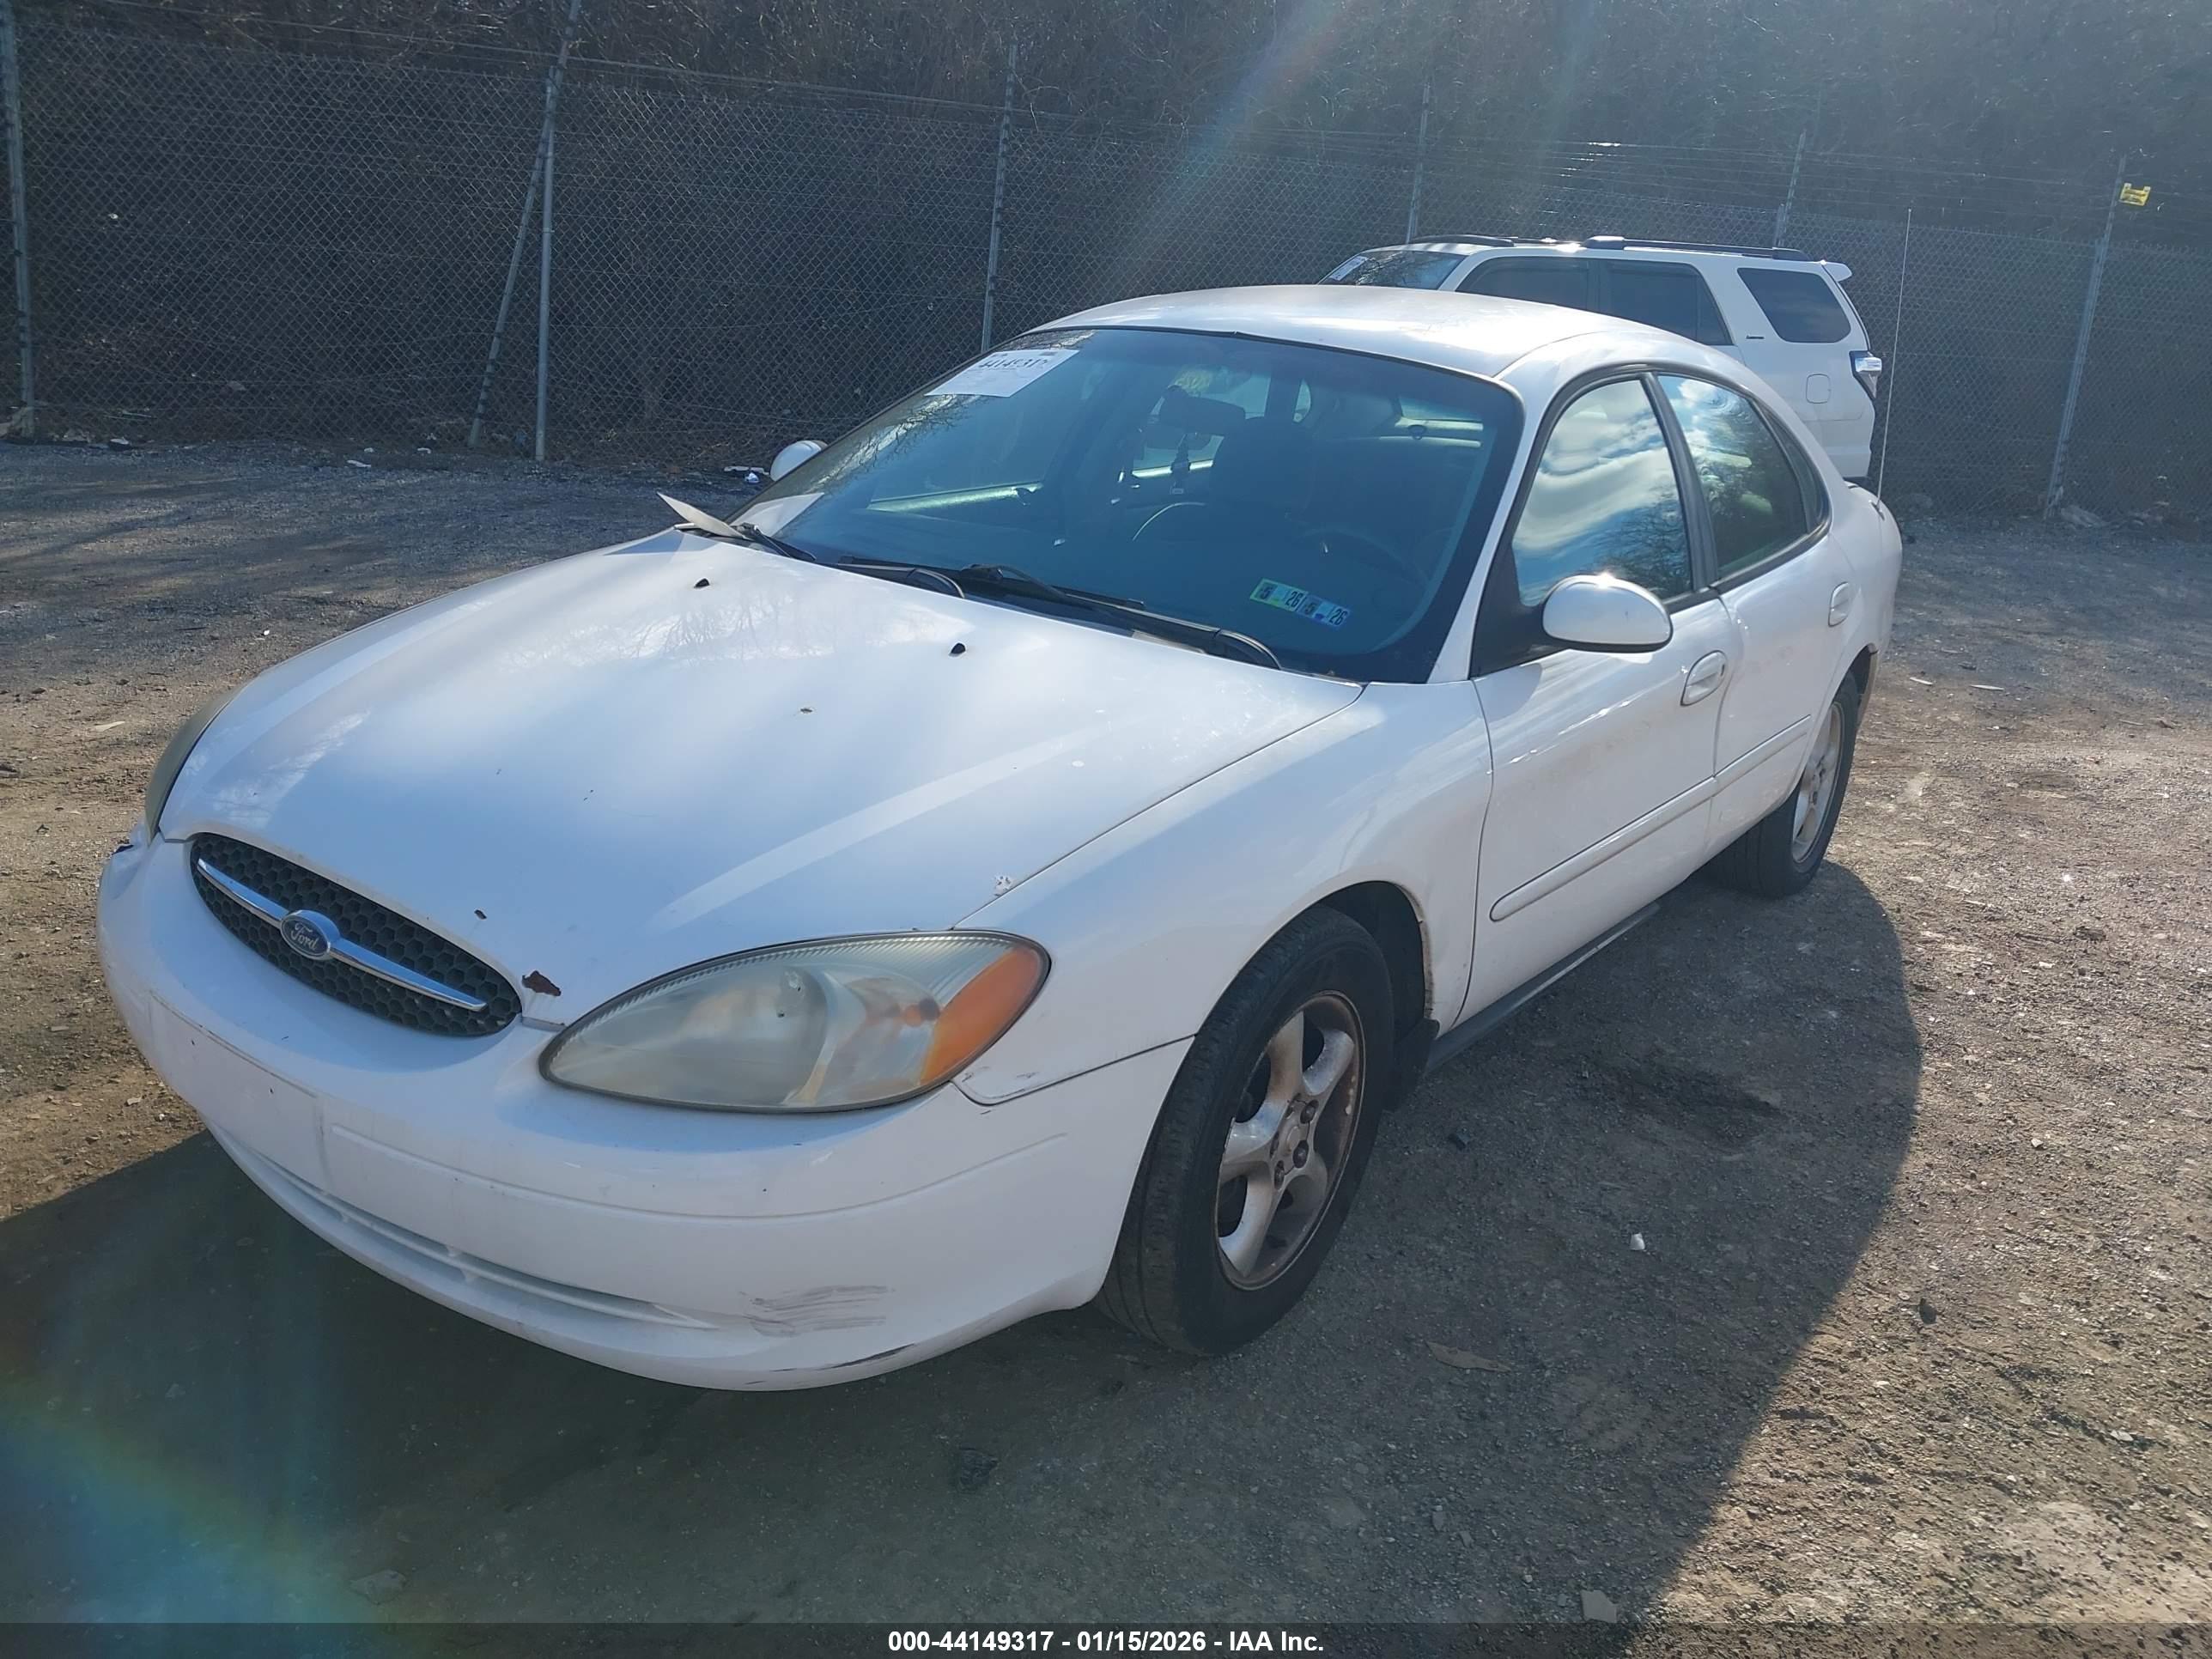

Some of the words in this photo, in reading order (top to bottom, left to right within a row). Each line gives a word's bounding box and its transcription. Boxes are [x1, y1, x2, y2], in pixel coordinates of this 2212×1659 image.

[1284, 591, 1304, 608] 26
[1328, 608, 1349, 626] 26
[289, 921, 320, 951] Ford
